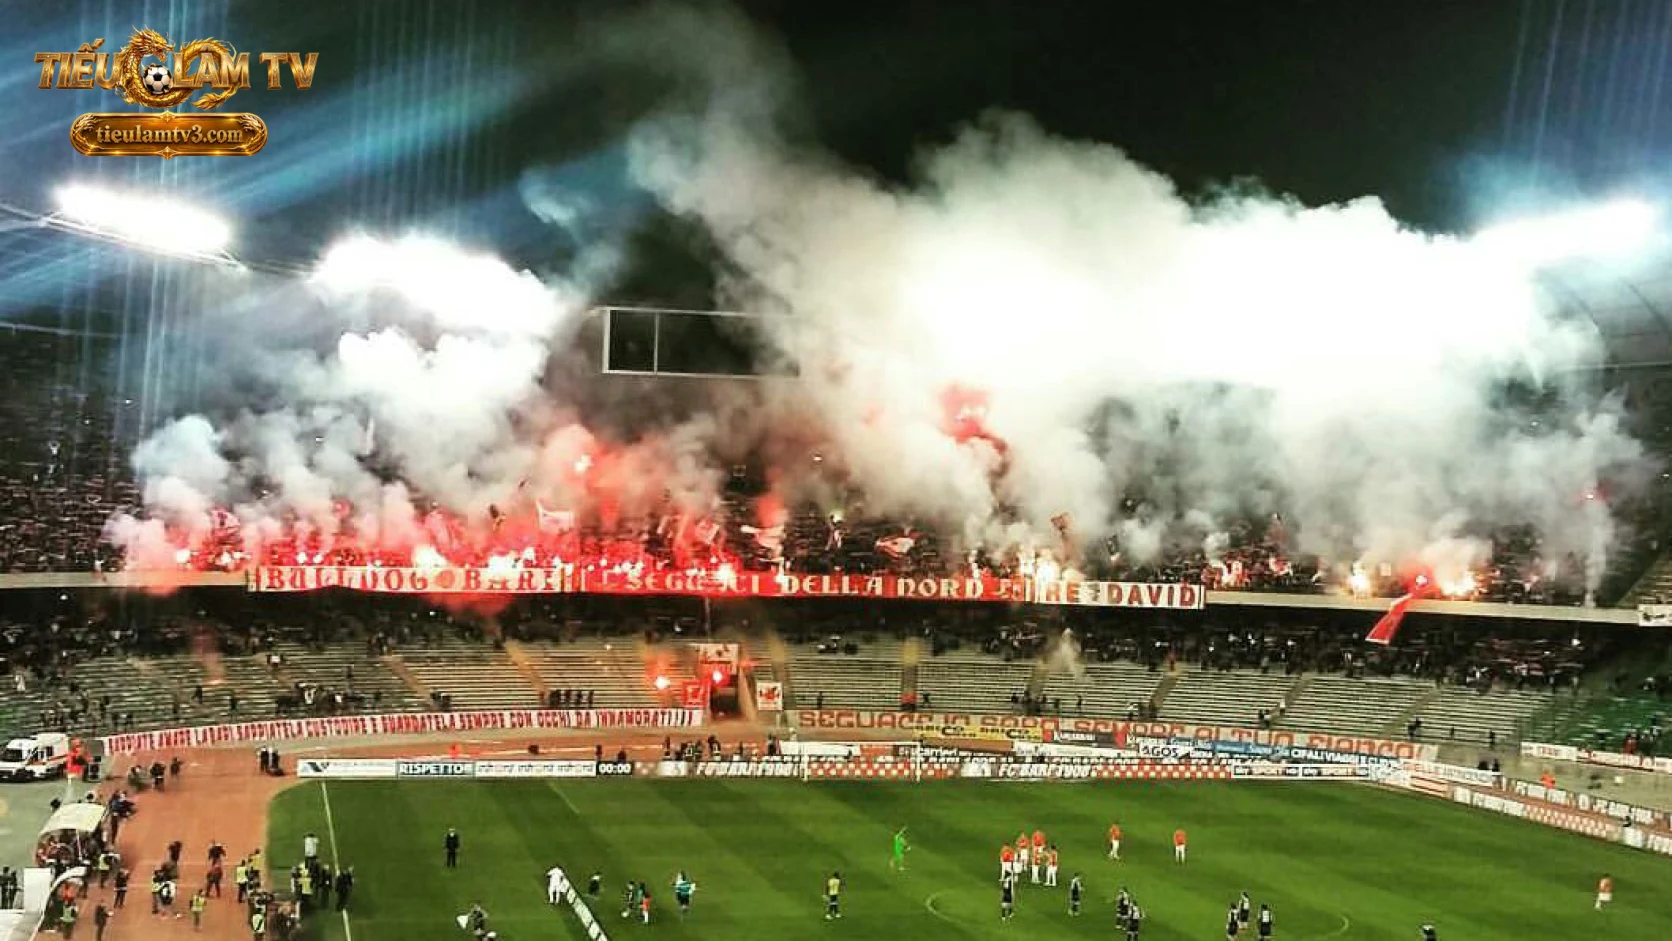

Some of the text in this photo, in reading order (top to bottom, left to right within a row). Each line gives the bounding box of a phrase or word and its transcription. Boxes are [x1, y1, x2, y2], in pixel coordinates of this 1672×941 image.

[779, 575, 883, 594] DELLA
[897, 577, 984, 598] NORD
[1107, 583, 1198, 607] DAVID
[400, 763, 465, 775] RISPETTO
[598, 763, 631, 774] 00:00
